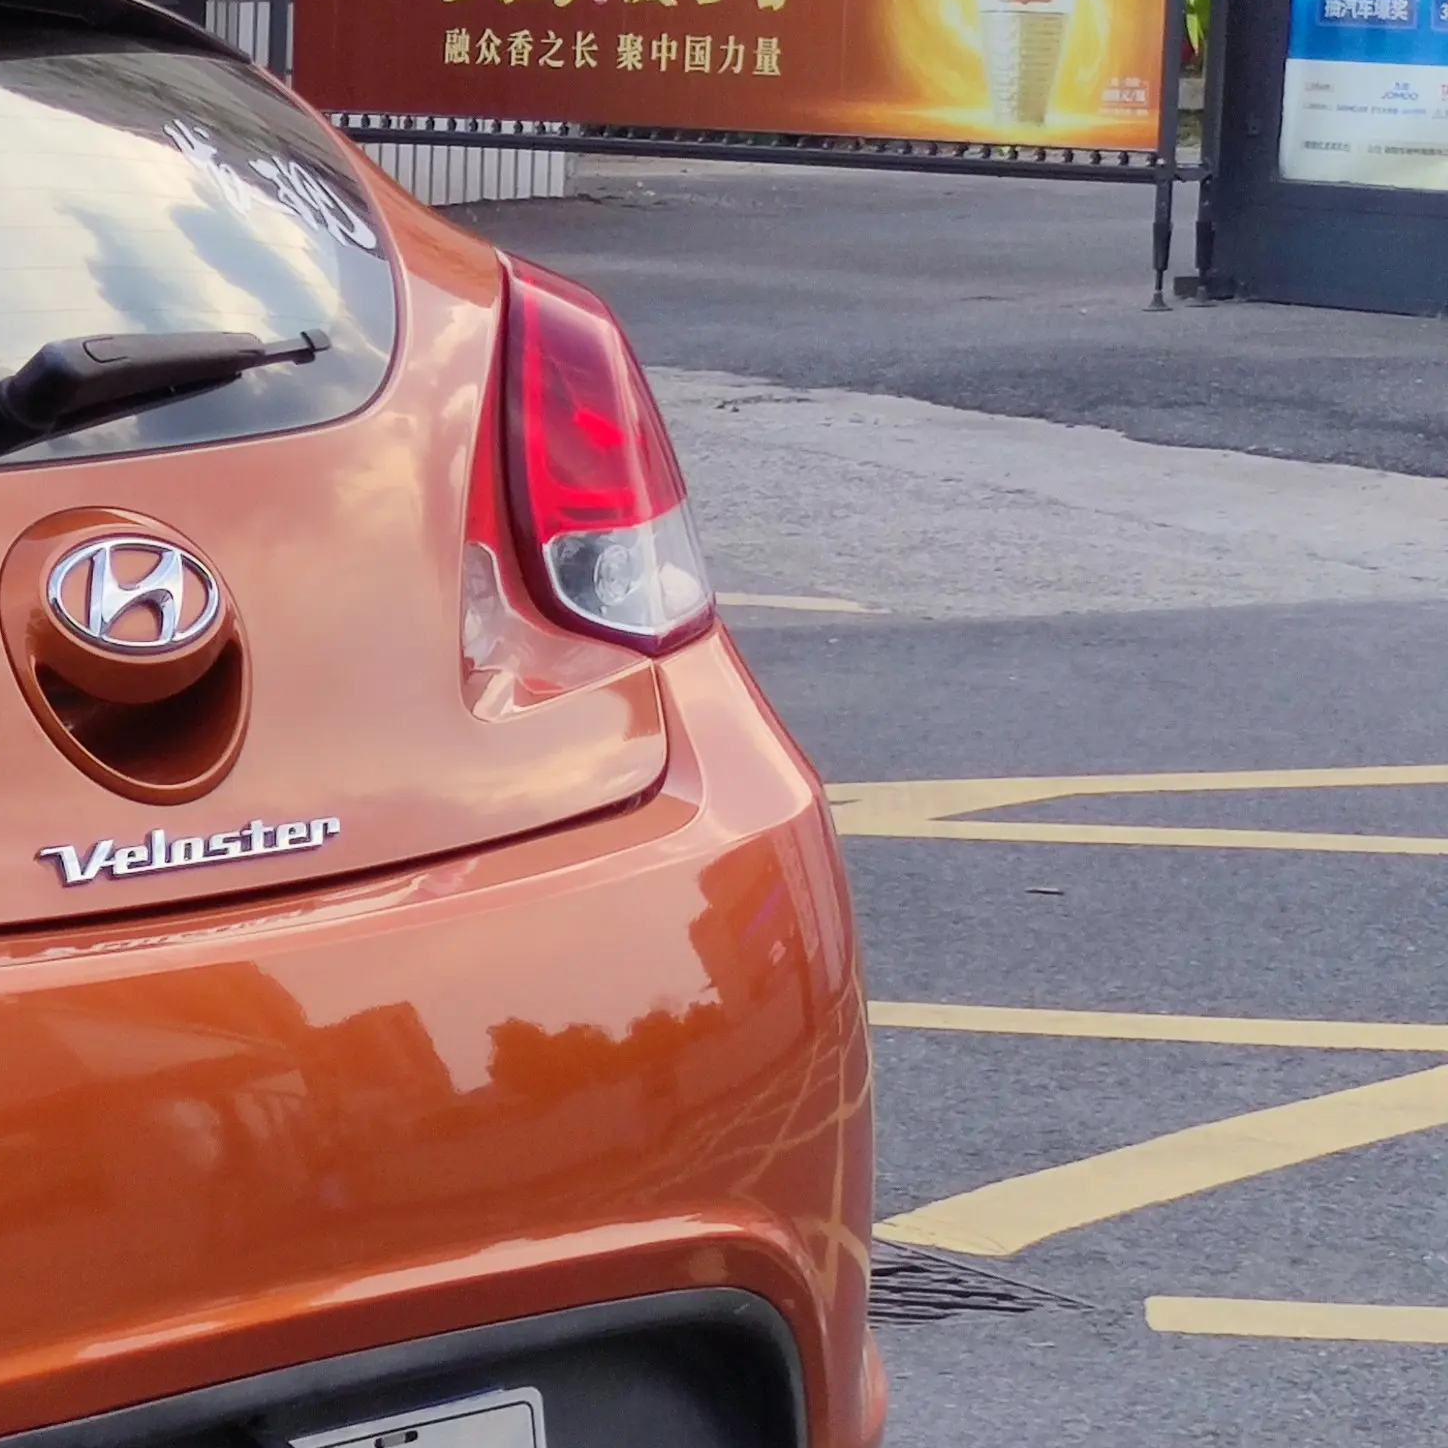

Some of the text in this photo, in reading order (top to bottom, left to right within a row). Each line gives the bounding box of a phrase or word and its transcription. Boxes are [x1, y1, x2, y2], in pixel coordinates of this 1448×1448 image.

[444, 28, 781, 76] 融众香之长 聚中国力量
[40, 816, 341, 885] Veloster
